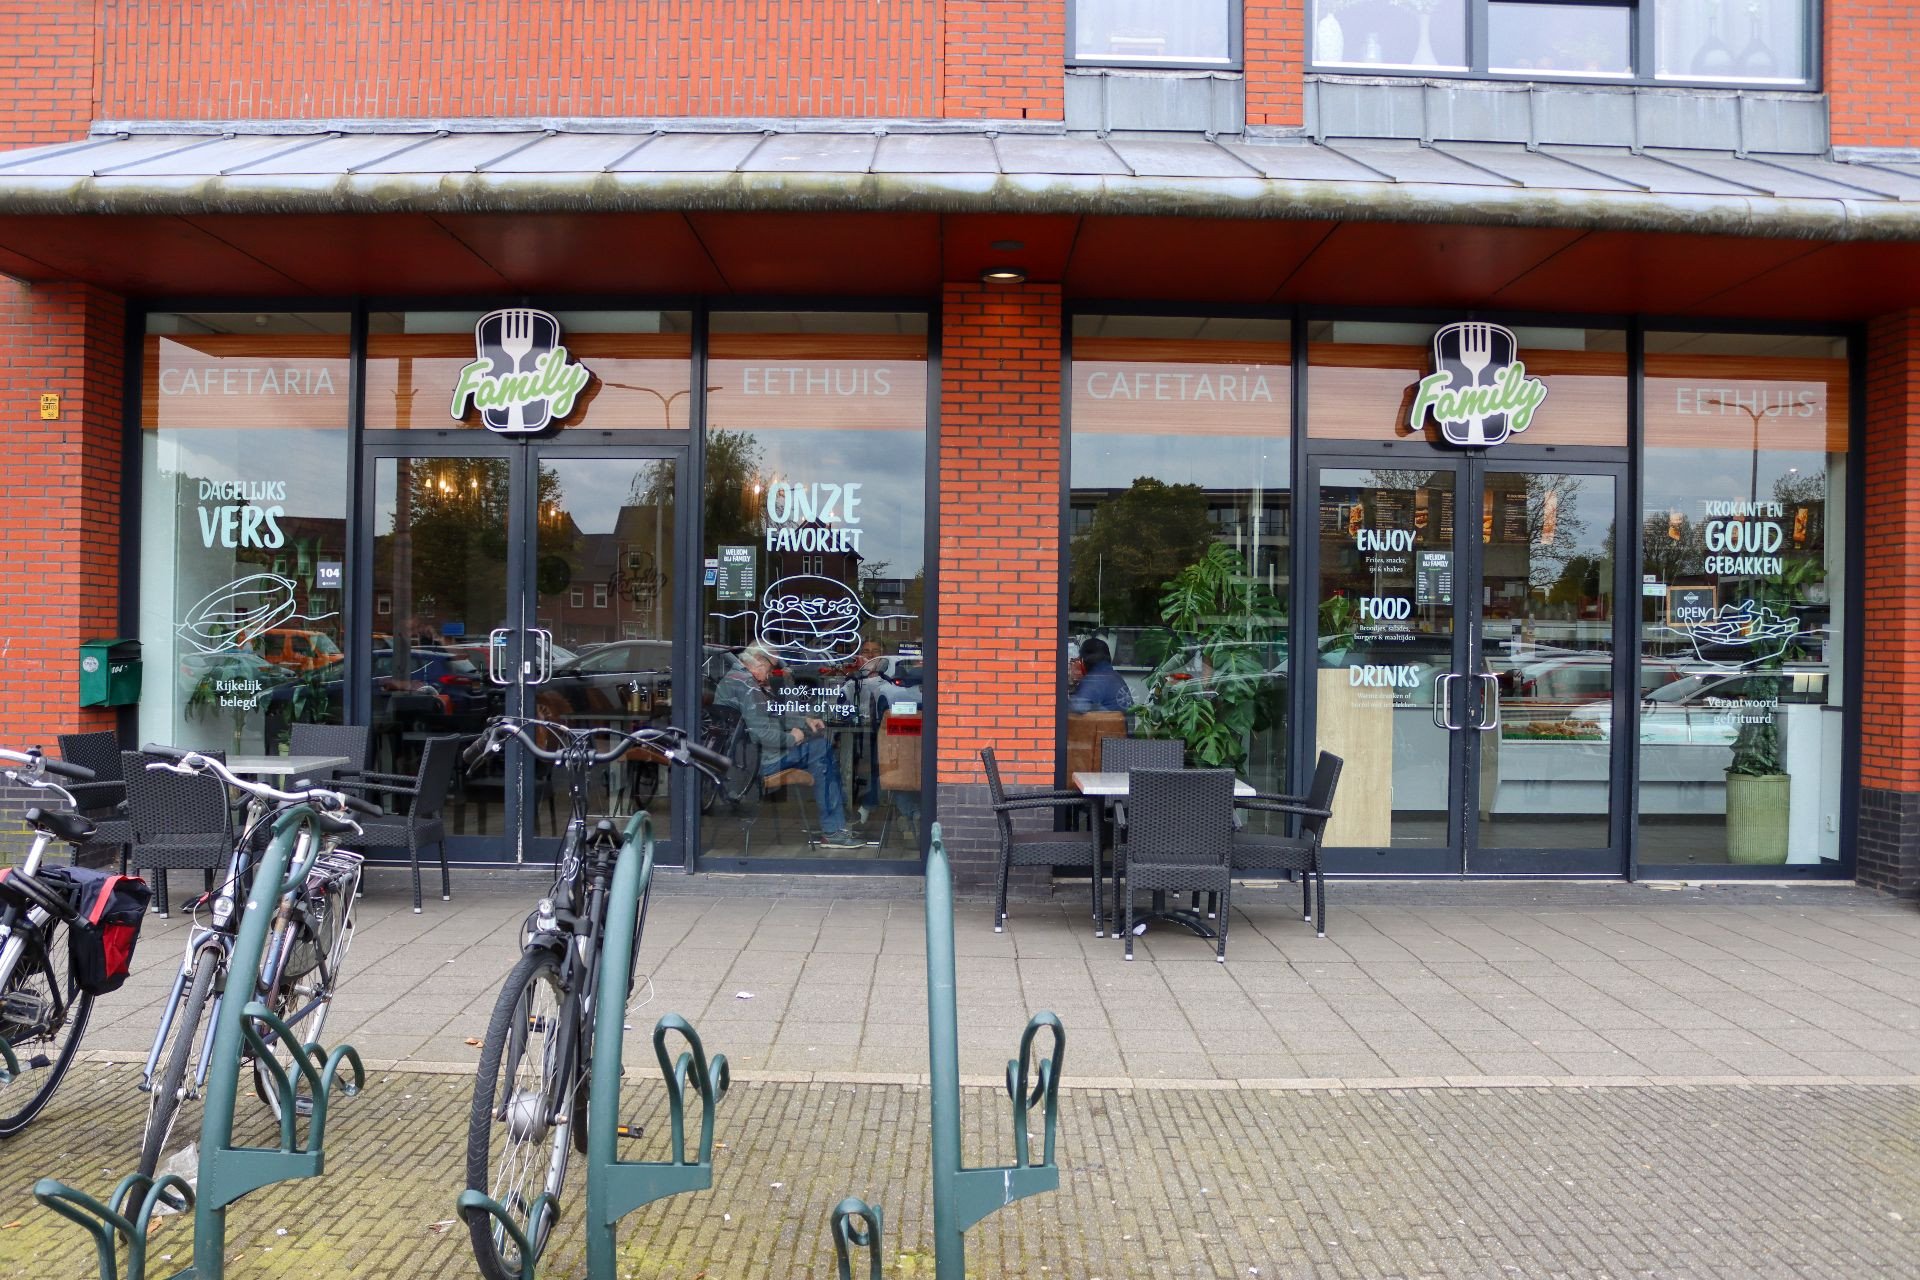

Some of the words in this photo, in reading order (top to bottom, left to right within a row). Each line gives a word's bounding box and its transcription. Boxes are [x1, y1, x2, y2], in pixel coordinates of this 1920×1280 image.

[159, 367, 336, 395] CAFETARIA
[452, 348, 589, 418] Family
[743, 367, 892, 396] EETHUIS
[1087, 371, 1273, 402] CAFETARIA
[1411, 361, 1548, 431] Family
[1676, 387, 1814, 418] EETHUIS
[199, 480, 286, 501] DAGELIJKS
[766, 482, 863, 524] ONZE
[1705, 500, 1763, 517] KROKANT
[1766, 502, 1783, 518] EN
[197, 505, 285, 549] VERS
[1705, 520, 1783, 554] GOUD
[766, 527, 864, 553] FAVORIET
[1357, 529, 1416, 552] ENJOY
[725, 548, 748, 556] WELKOM
[1424, 553, 1446, 561] WELKOM
[320, 568, 340, 578] 104
[1704, 555, 1783, 576] GEBAKKEN
[1360, 597, 1411, 620] FOOD
[1677, 606, 1706, 618] OPEN
[1384, 634, 1416, 643] maaltijden
[1349, 664, 1420, 688] DRINKS
[215, 680, 262, 695] Rijkelijk
[780, 685, 808, 697] 100%
[811, 685, 844, 698] rund,
[220, 695, 257, 711] belegd
[767, 700, 811, 716] kipfilet
[813, 701, 827, 713] of
[829, 703, 856, 717] vega
[1706, 696, 1778, 708] Verantwoord
[1713, 712, 1772, 726] gefrituurd
